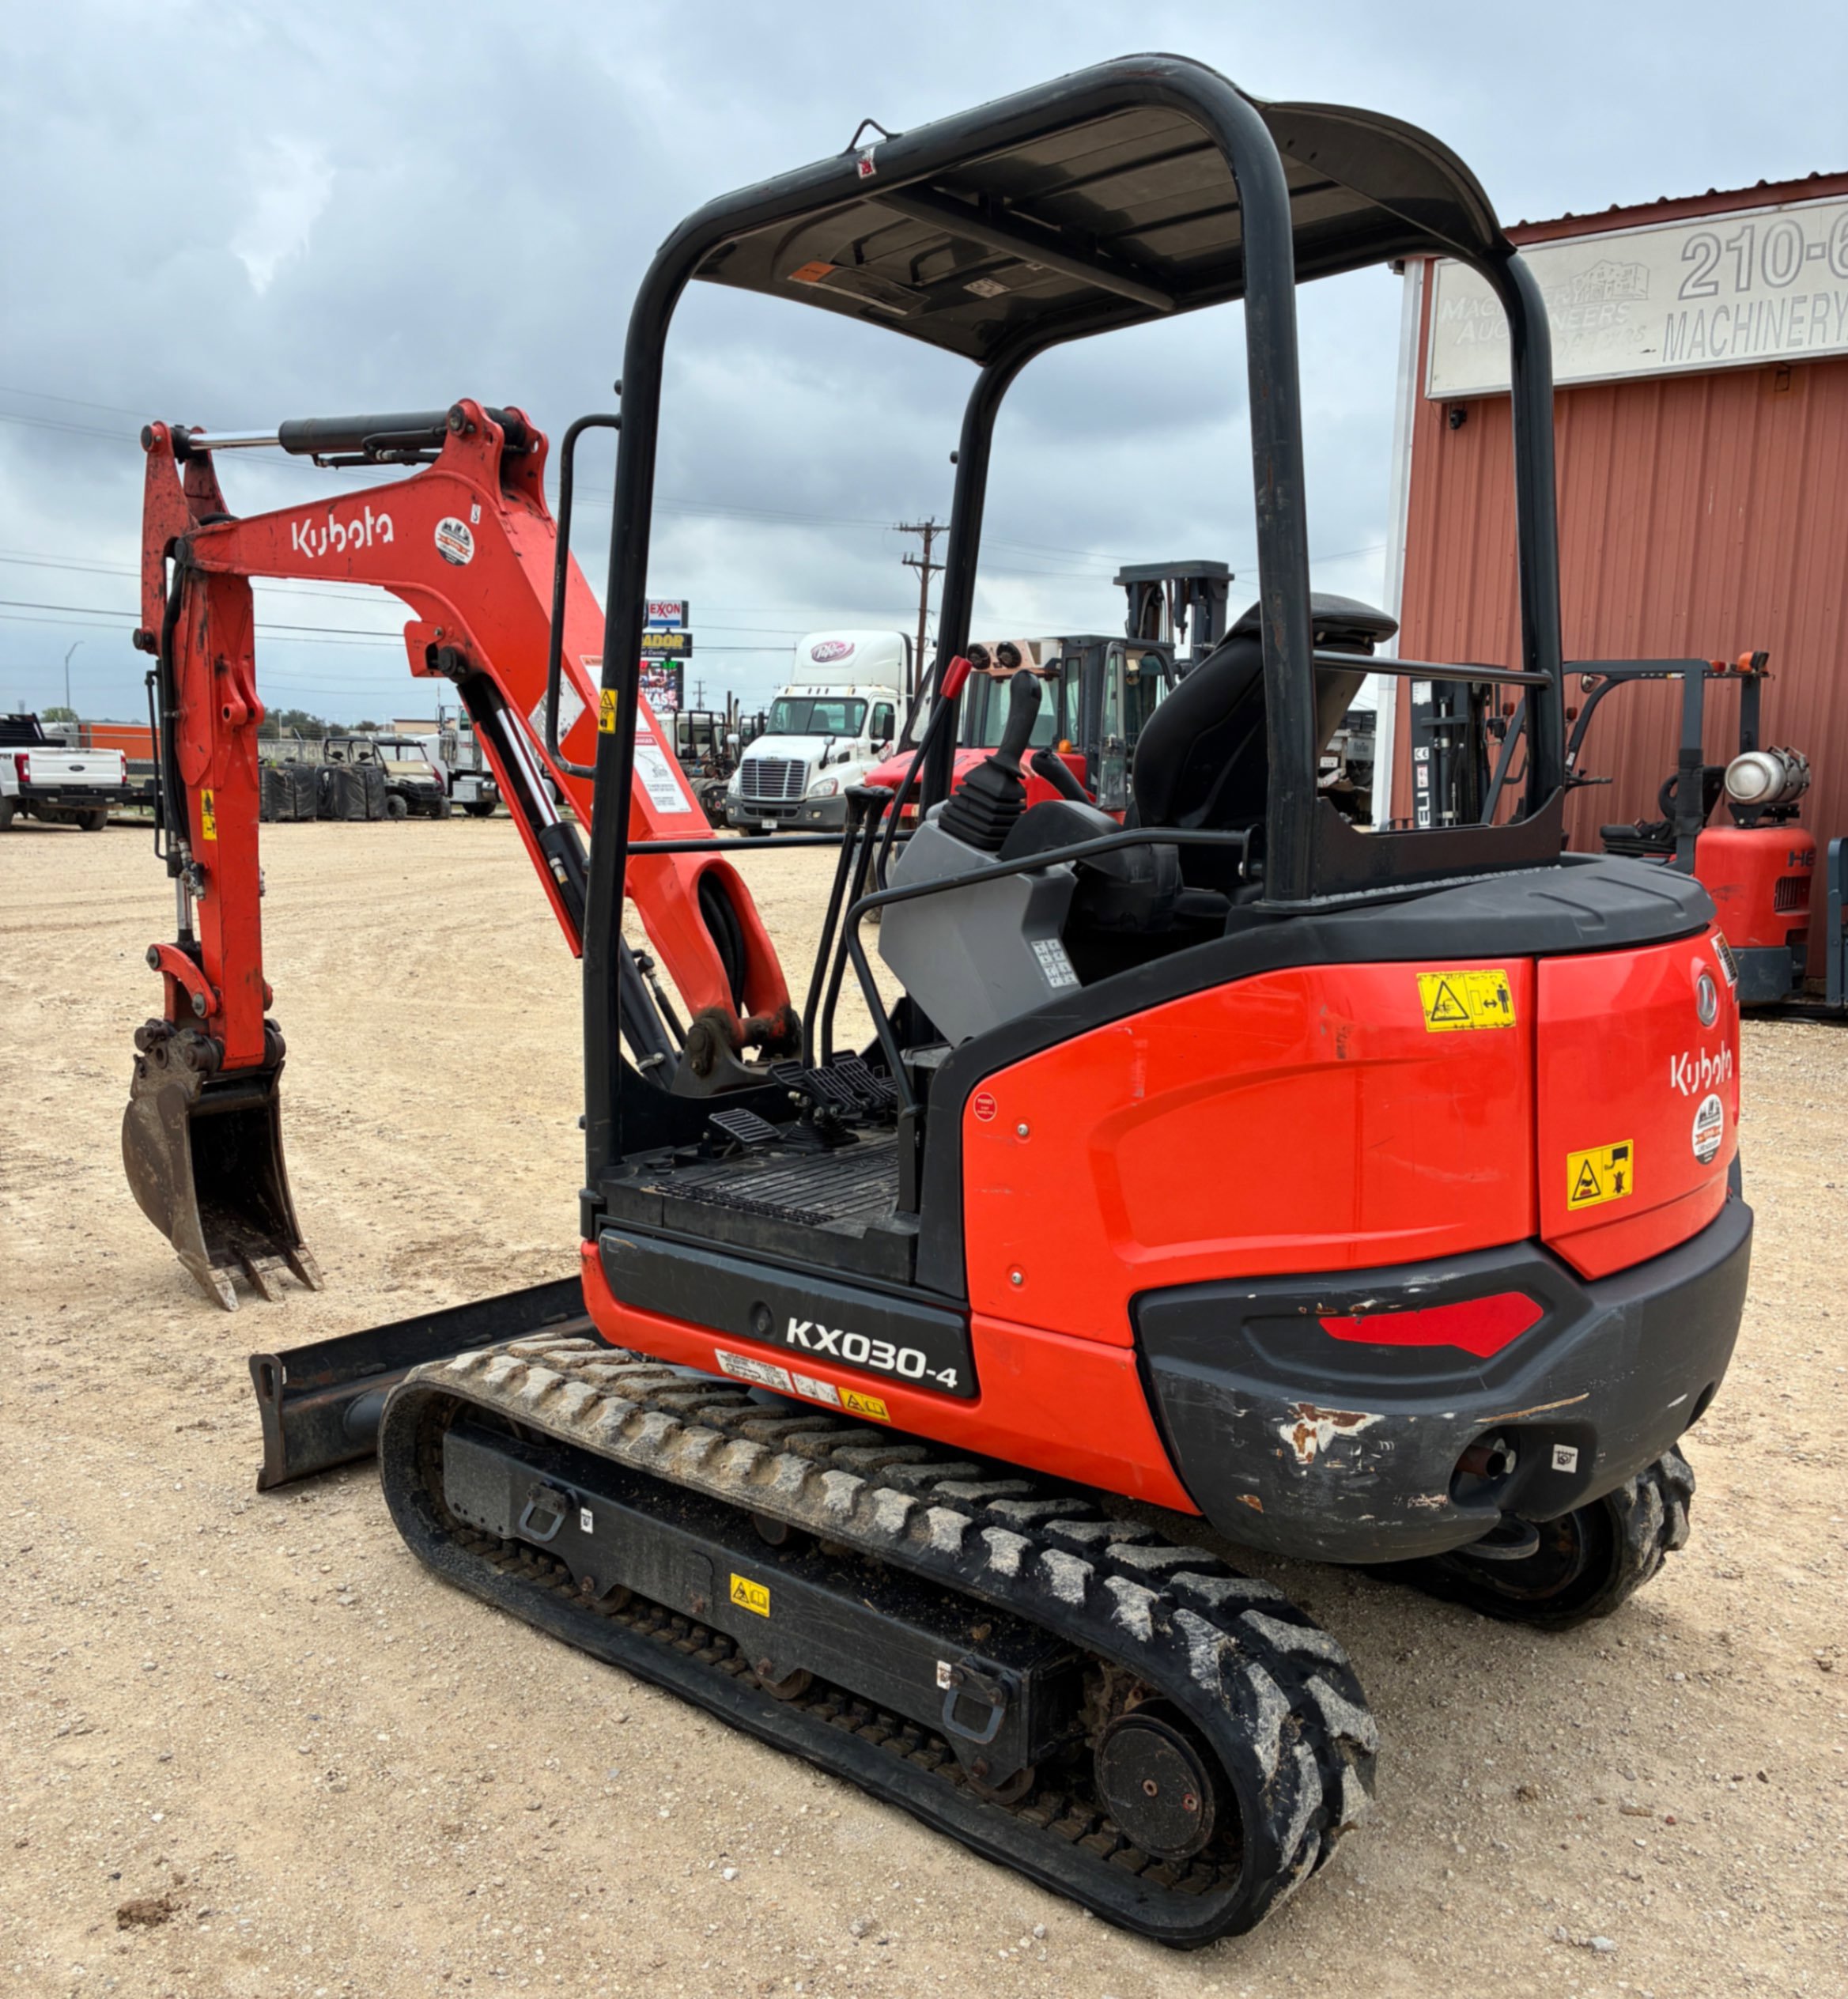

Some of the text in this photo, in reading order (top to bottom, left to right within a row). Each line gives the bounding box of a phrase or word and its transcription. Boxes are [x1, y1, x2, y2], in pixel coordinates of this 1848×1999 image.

[1662, 289, 1848, 363] MACHINERY
[291, 505, 395, 558] Kubota
[649, 603, 681, 618] EXXON
[641, 634, 684, 648] ADOR
[1417, 791, 1431, 829] ELI
[1670, 1039, 1733, 1097] Kubota
[786, 1317, 958, 1389] KX030-4
